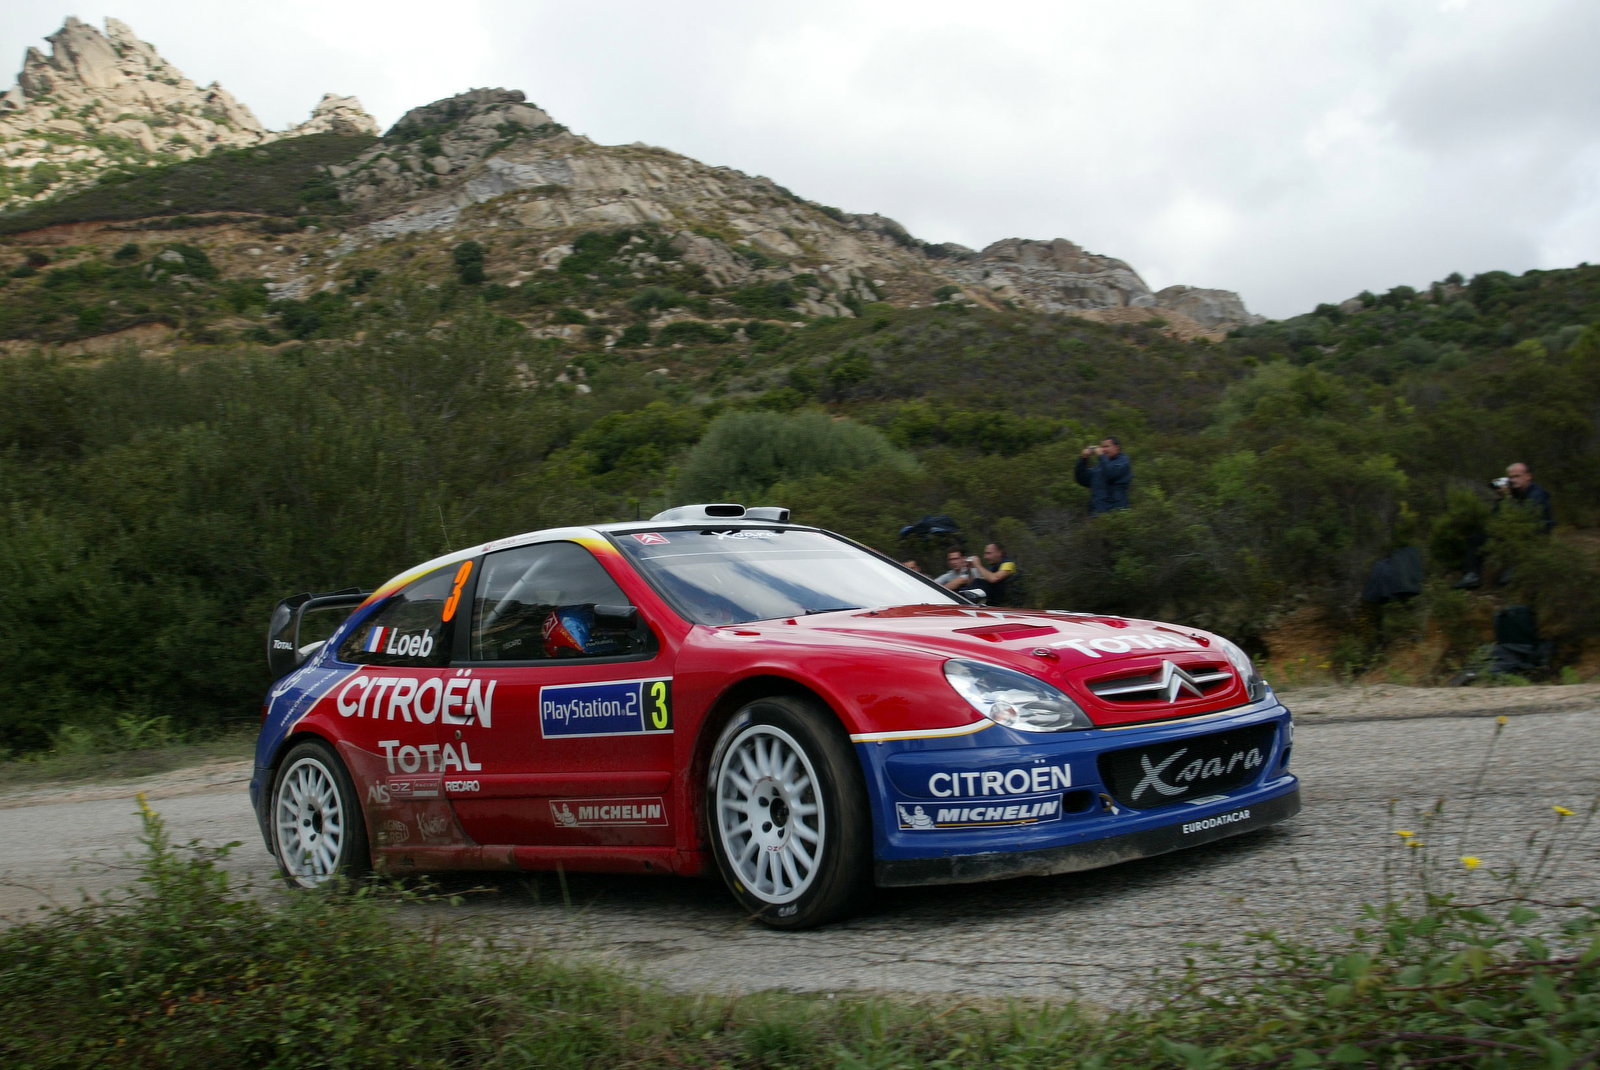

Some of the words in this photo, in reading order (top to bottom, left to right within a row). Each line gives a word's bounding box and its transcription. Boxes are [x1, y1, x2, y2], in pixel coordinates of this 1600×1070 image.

[442, 560, 474, 623] 3
[273, 640, 294, 650] TOTAL
[386, 627, 434, 658] Loeb
[1050, 633, 1200, 658] TOTAL
[336, 668, 497, 729] CITROËN
[650, 681, 669, 730] 3
[378, 740, 482, 774] TOTAL
[391, 783, 411, 792] OZ
[445, 781, 480, 792] RECARO
[928, 759, 1073, 798] CITROËN
[1131, 747, 1264, 801] Xsara
[578, 804, 661, 820] MICHELIN
[936, 800, 1060, 822] MICHELIN
[1182, 809, 1250, 834] EURODATACAR
